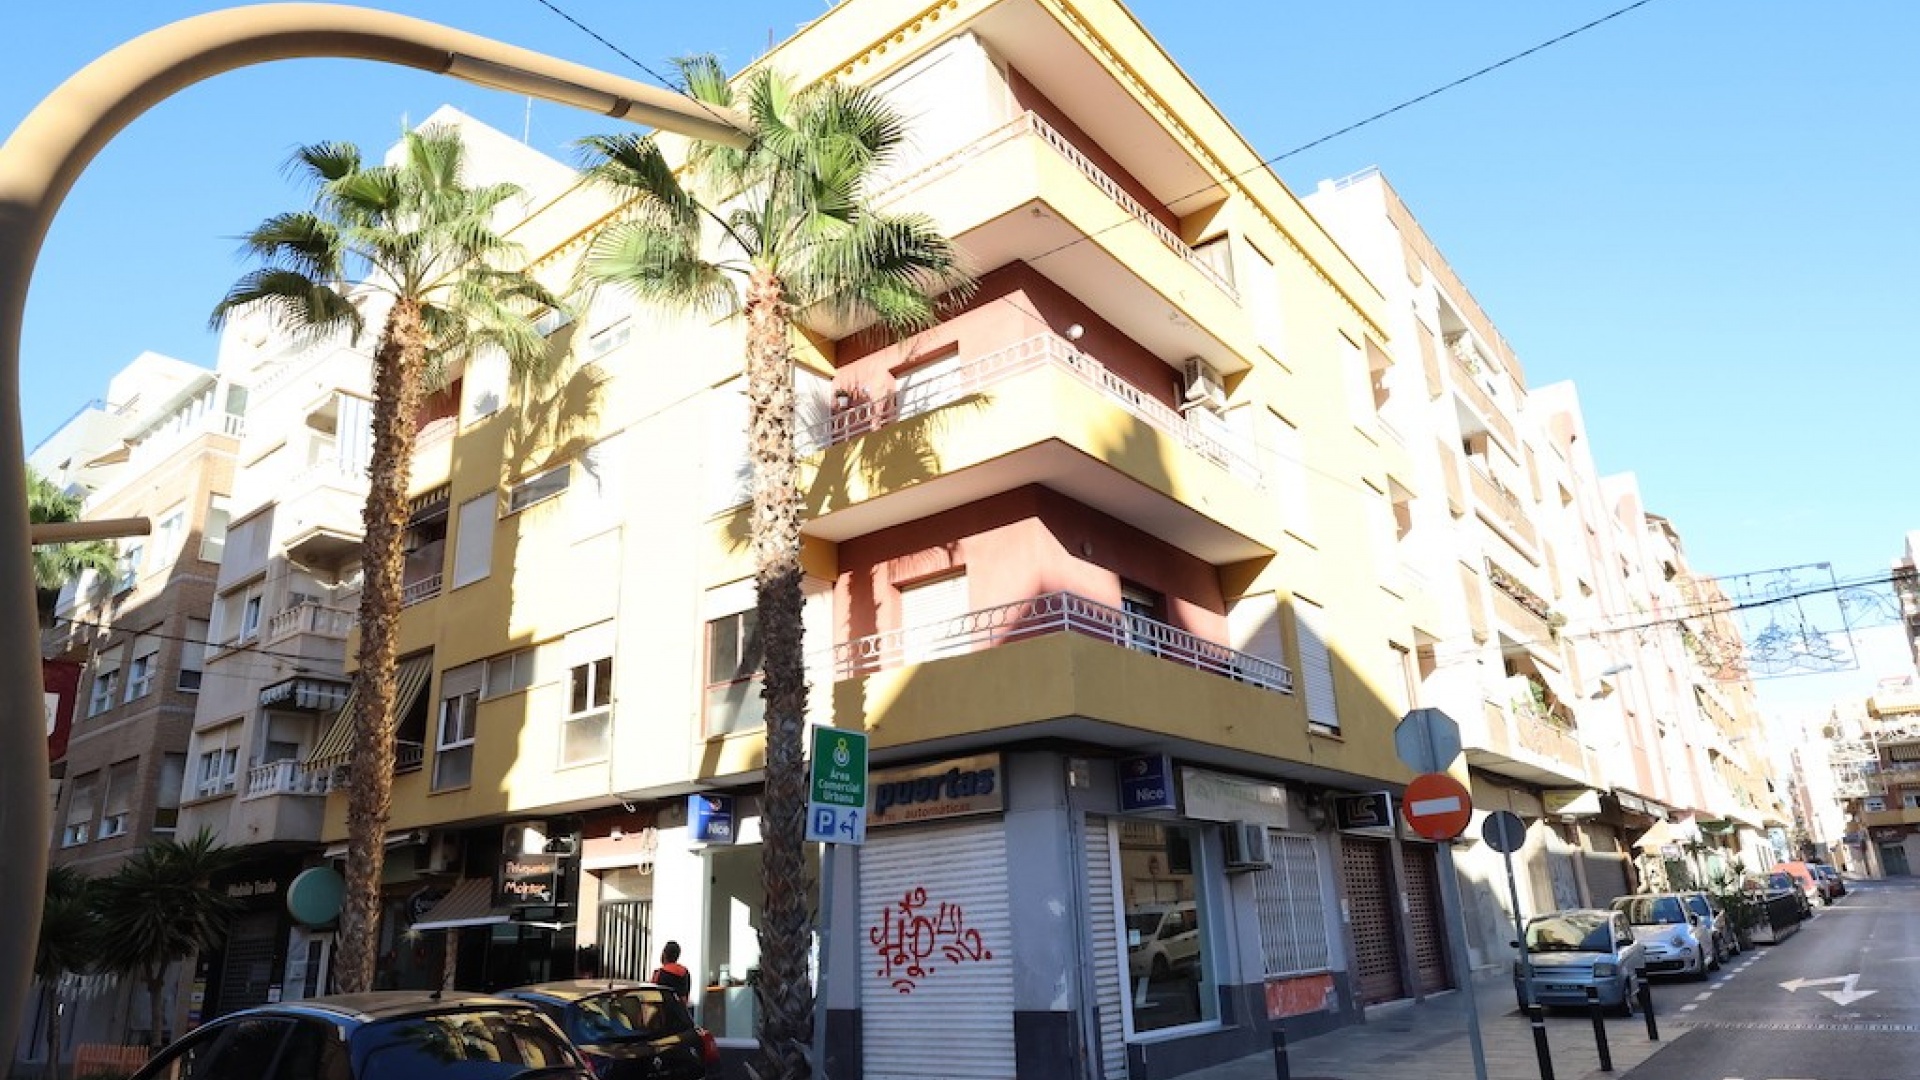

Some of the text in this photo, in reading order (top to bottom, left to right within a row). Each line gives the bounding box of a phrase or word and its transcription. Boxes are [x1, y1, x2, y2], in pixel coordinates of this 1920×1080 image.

[818, 778, 860, 794] Comercial
[874, 767, 995, 817] puertas
[823, 789, 854, 804] Urbana
[1135, 787, 1165, 802] Nice
[708, 821, 730, 836] Nice
[818, 810, 833, 832] P
